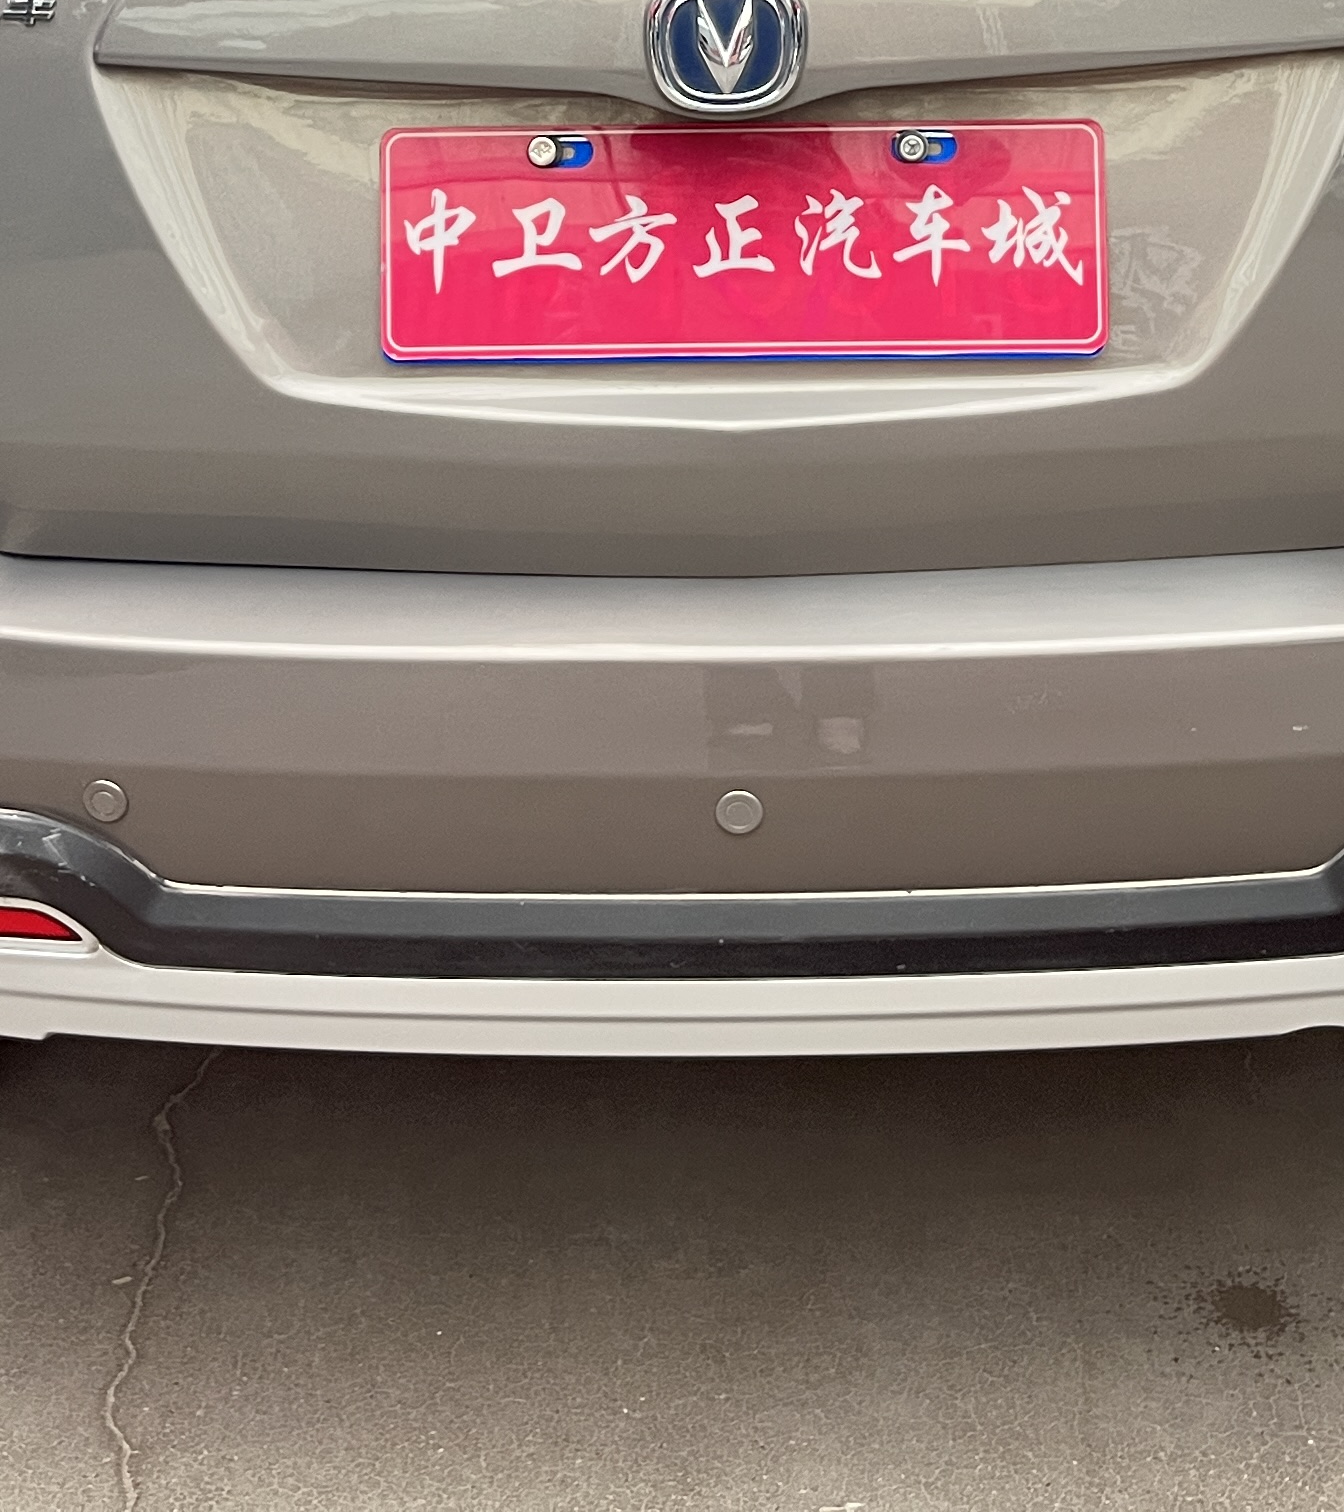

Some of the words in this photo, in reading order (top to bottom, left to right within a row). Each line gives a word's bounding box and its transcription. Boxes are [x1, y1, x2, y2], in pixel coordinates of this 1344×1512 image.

[402, 182, 1086, 295] 中卫方正汽车城
